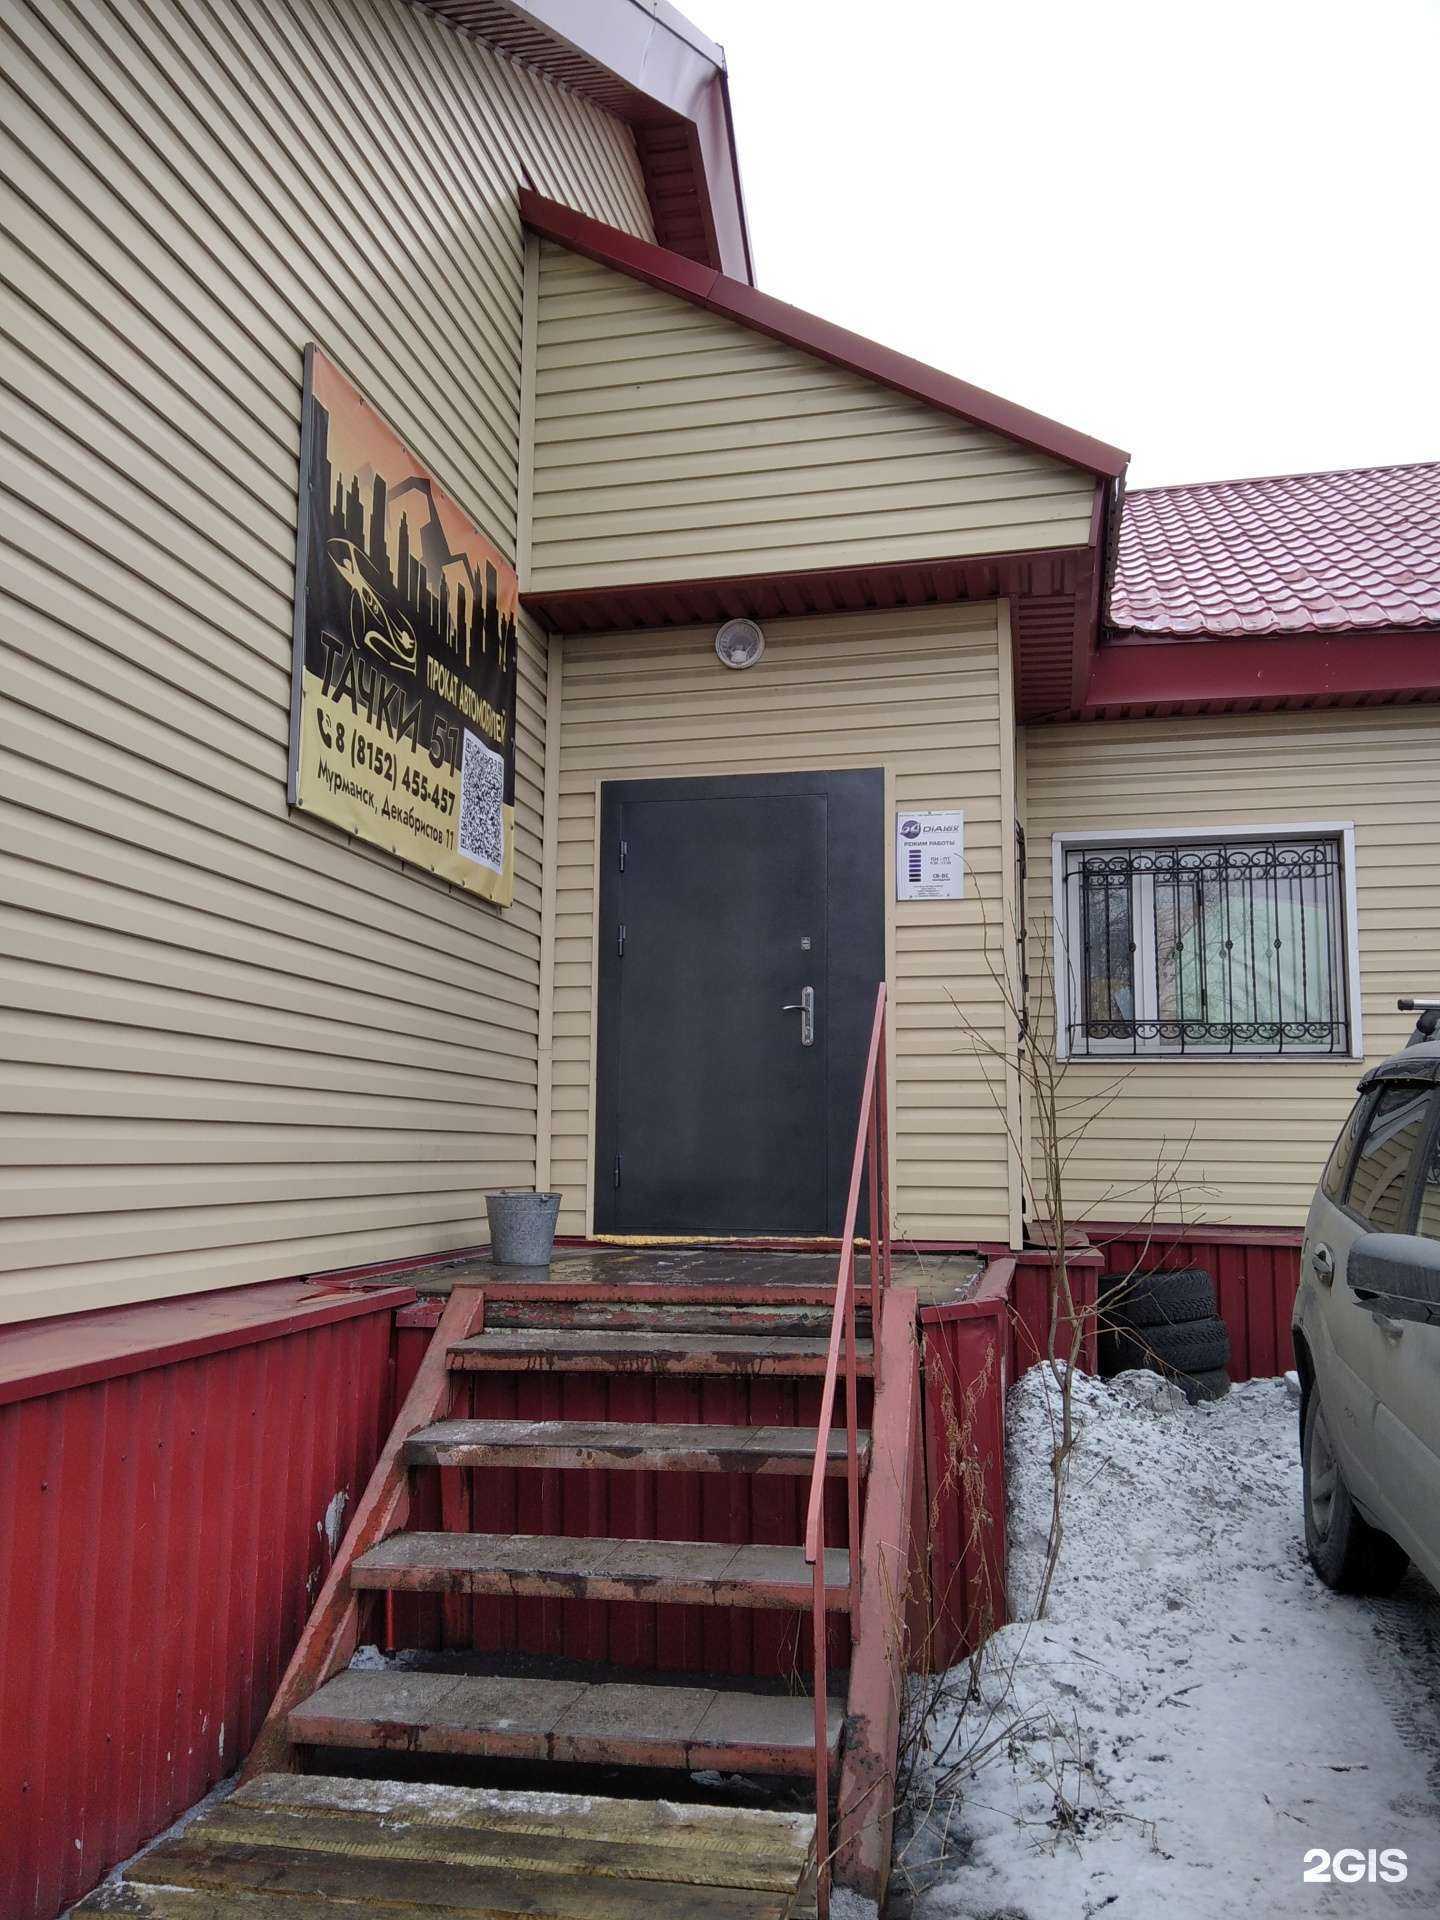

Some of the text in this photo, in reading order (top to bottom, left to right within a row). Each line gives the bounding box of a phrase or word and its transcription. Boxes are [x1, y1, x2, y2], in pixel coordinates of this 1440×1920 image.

[321, 630, 460, 778] ТАЧКИ 51
[427, 654, 507, 745] ПРОКАТ АВТОМОБИЛЕЙ
[317, 756, 454, 850] Мурманск, Декабристов 11
[335, 722, 456, 816] 8 (8152) 455-457
